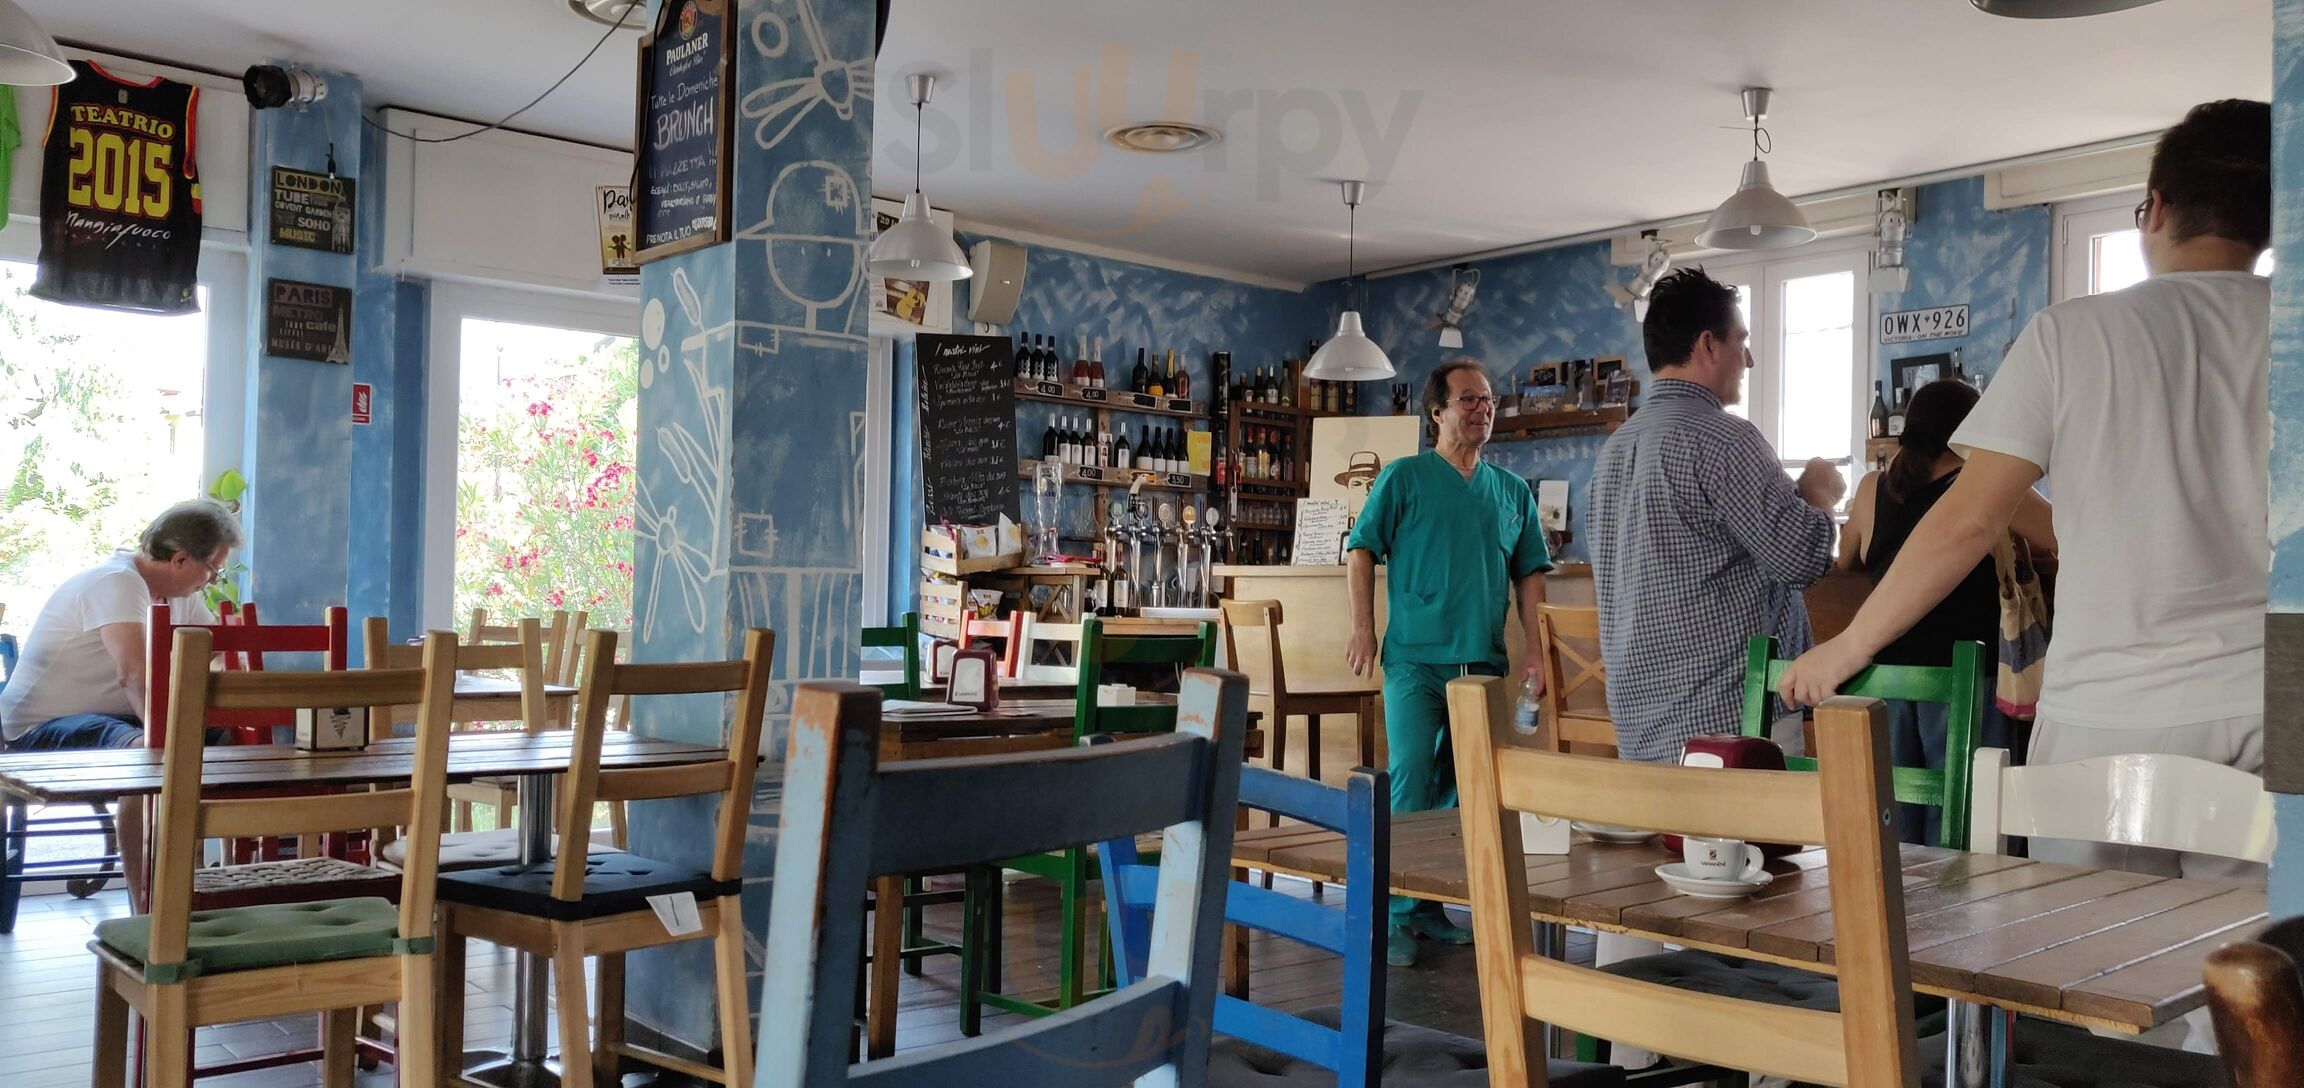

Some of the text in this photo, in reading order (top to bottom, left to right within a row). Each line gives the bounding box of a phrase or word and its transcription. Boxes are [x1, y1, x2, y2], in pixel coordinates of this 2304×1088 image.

[666, 32, 709, 65] PAULANER
[668, 90, 675, 103] le
[677, 71, 719, 101] Domeniche
[70, 105, 175, 139] TEATRIO
[655, 96, 714, 151] BRUNCH
[68, 127, 173, 218] 2015
[276, 171, 341, 194] LONDON
[275, 189, 310, 205] TUBE
[275, 201, 303, 213] COVENT
[297, 217, 331, 232] SOHO
[646, 231, 673, 244] PRENOTA
[679, 225, 692, 239] TUO
[275, 284, 331, 305] PARIS
[272, 305, 323, 320] METRO
[1884, 308, 1965, 335] OWX 926
